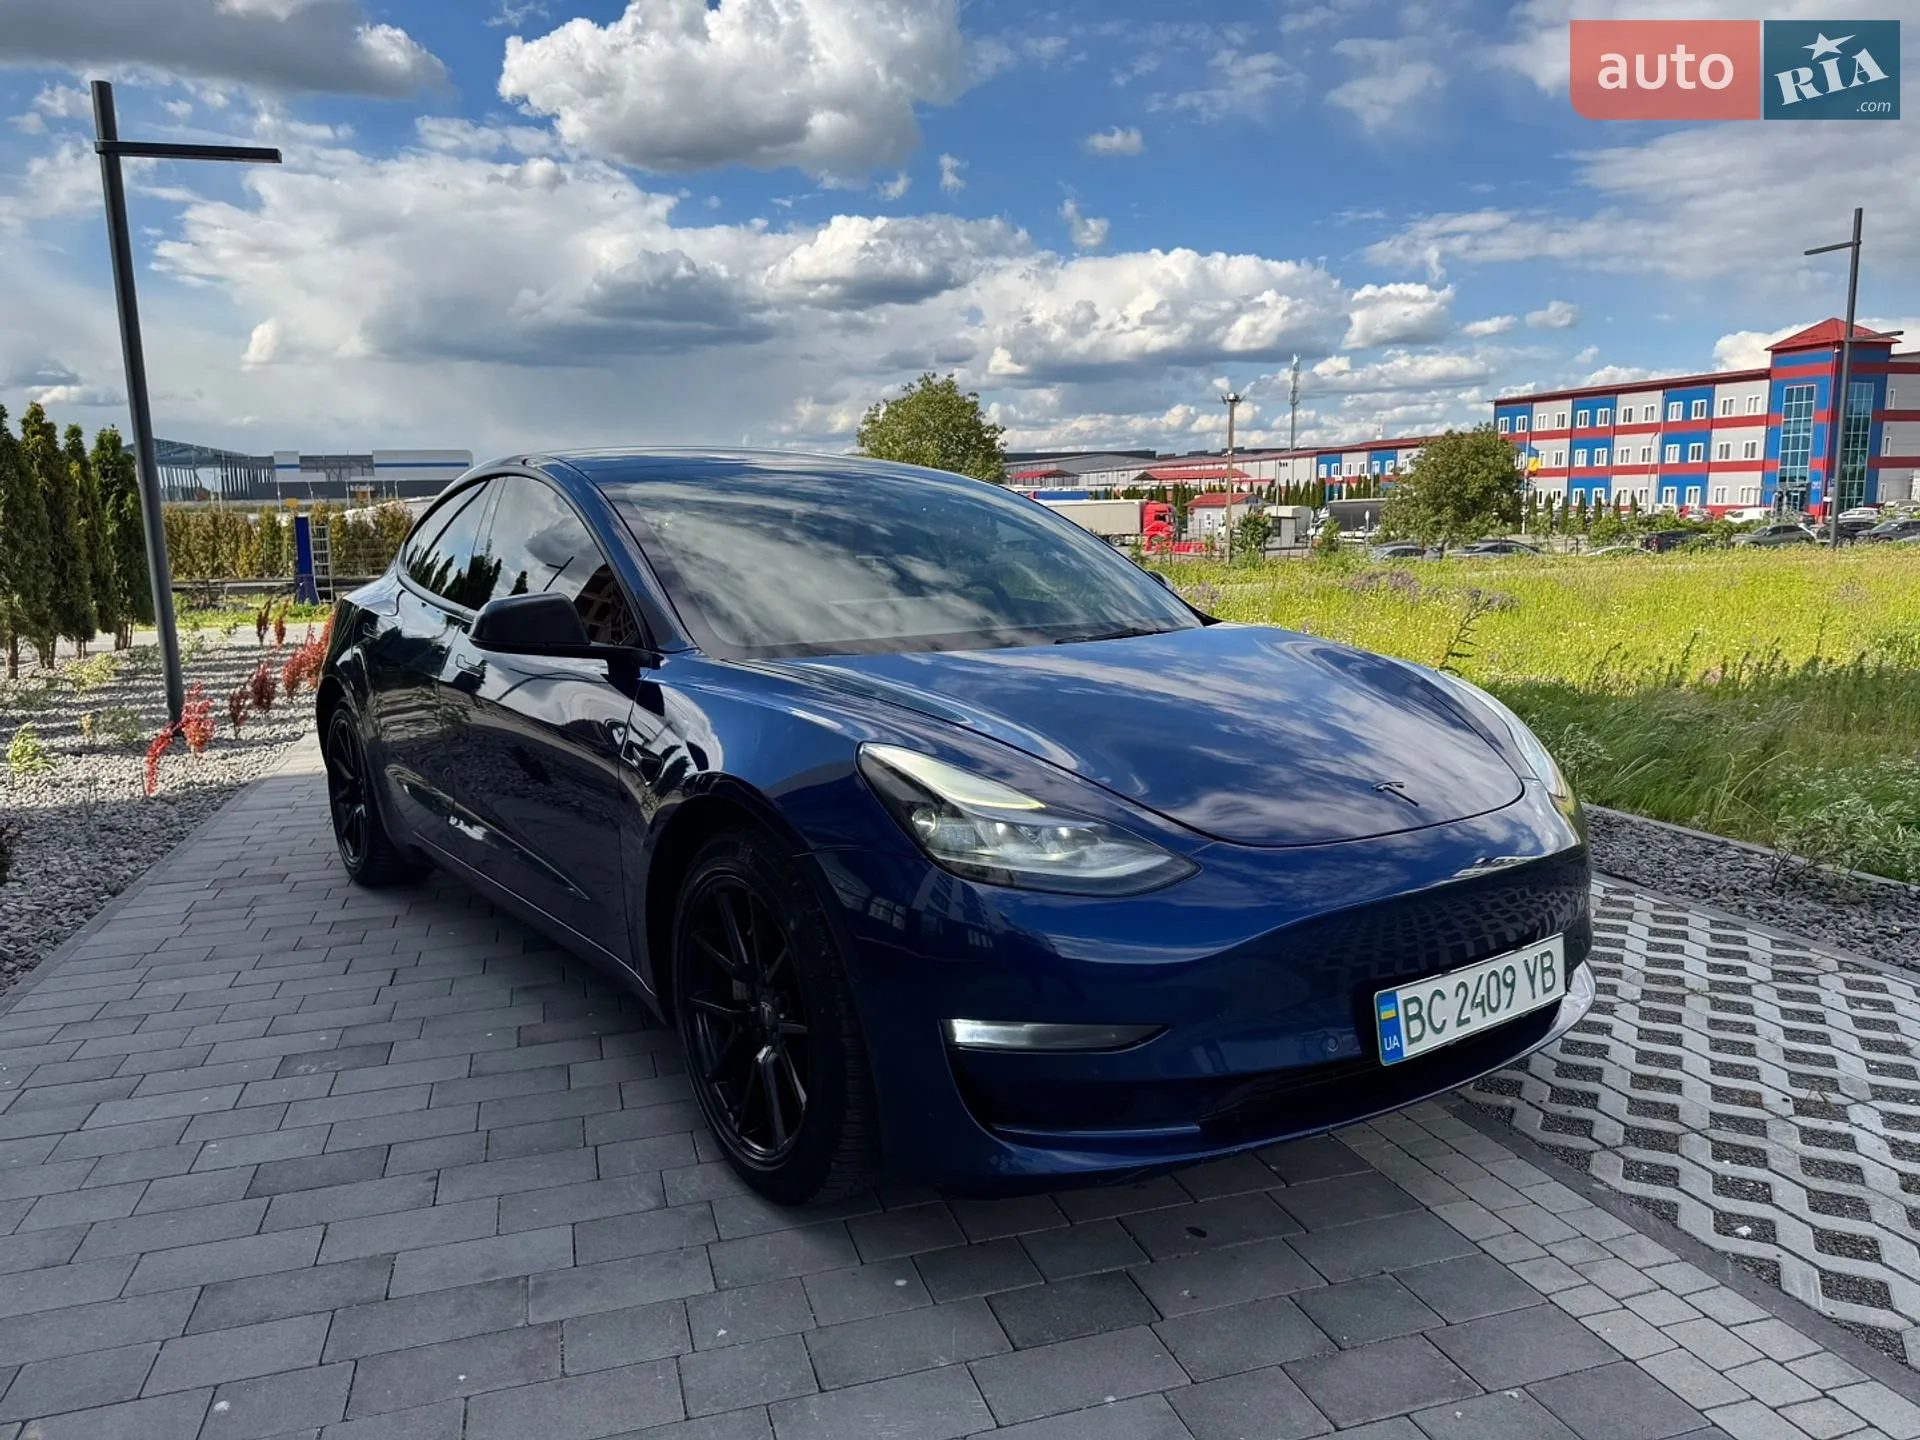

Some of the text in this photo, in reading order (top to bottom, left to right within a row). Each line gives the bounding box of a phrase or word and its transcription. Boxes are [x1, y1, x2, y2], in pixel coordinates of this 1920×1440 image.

[1402, 949, 1556, 1046] BC 2409 YB
[1383, 1035, 1401, 1052] UA
